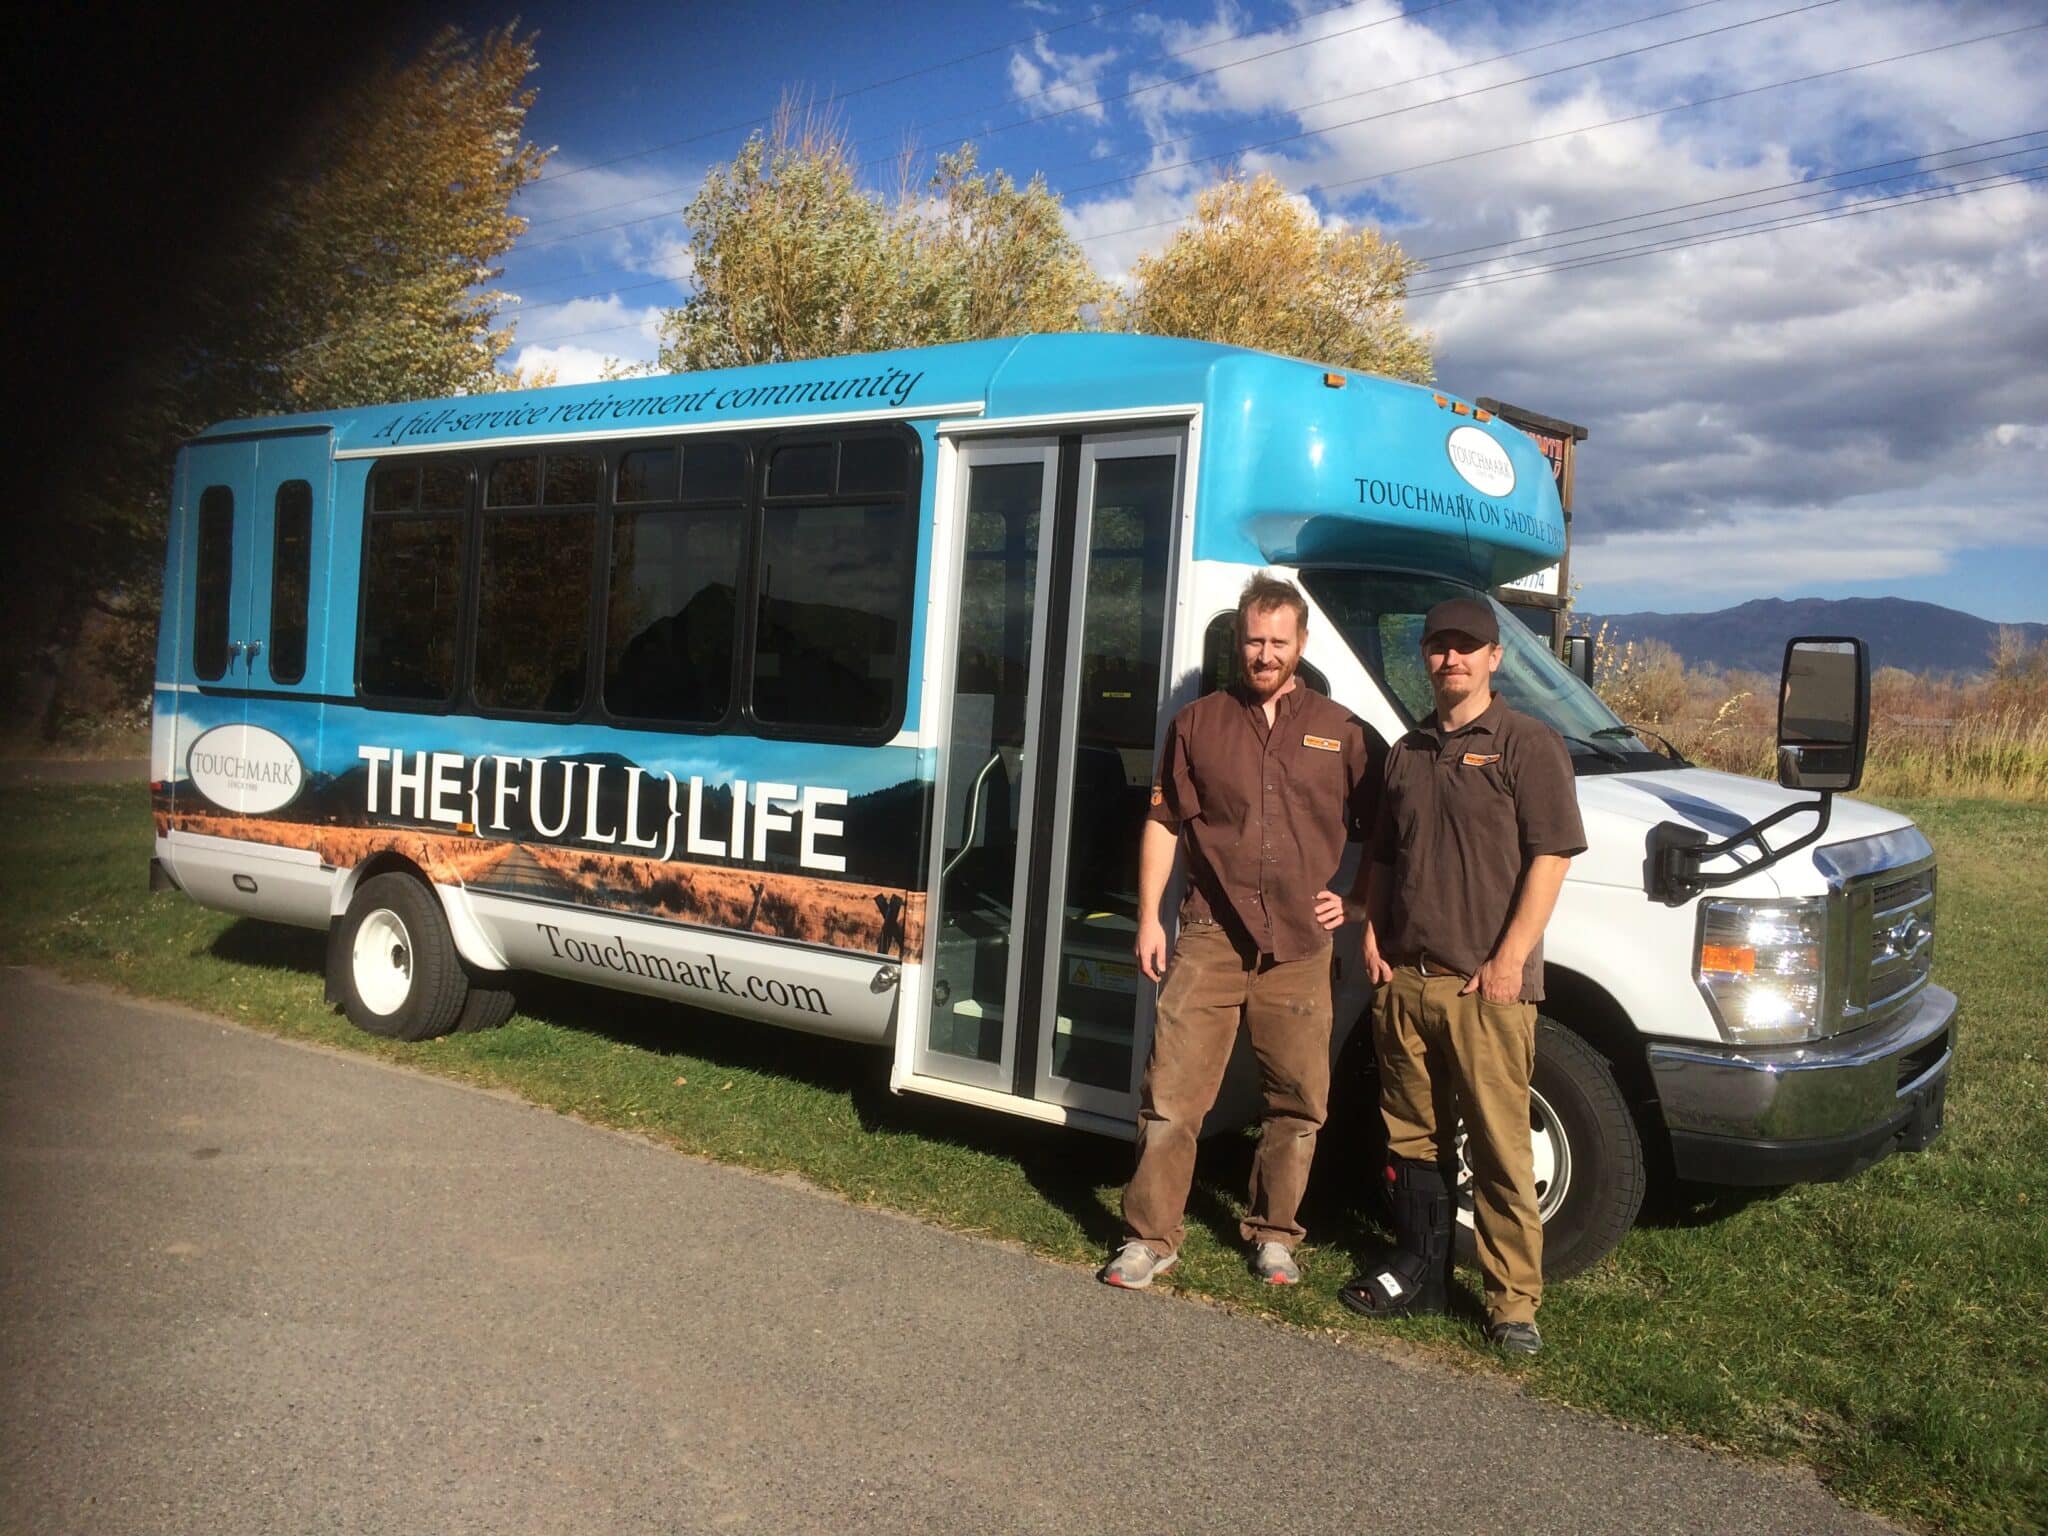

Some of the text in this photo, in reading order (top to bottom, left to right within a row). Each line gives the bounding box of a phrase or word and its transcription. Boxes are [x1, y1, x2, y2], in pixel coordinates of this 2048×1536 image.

[372, 367, 924, 446] A full-service retirement community
[1450, 443, 1510, 474] TOUCHMARK
[1355, 478, 1477, 522] TOUCHMARK
[1479, 501, 1500, 527] ON
[1503, 508, 1545, 542] SADDLE
[194, 751, 294, 786] TOUCHMARK
[358, 745, 464, 824] THE
[686, 775, 849, 873] LIFE
[537, 922, 833, 1017] Touchmark.com
